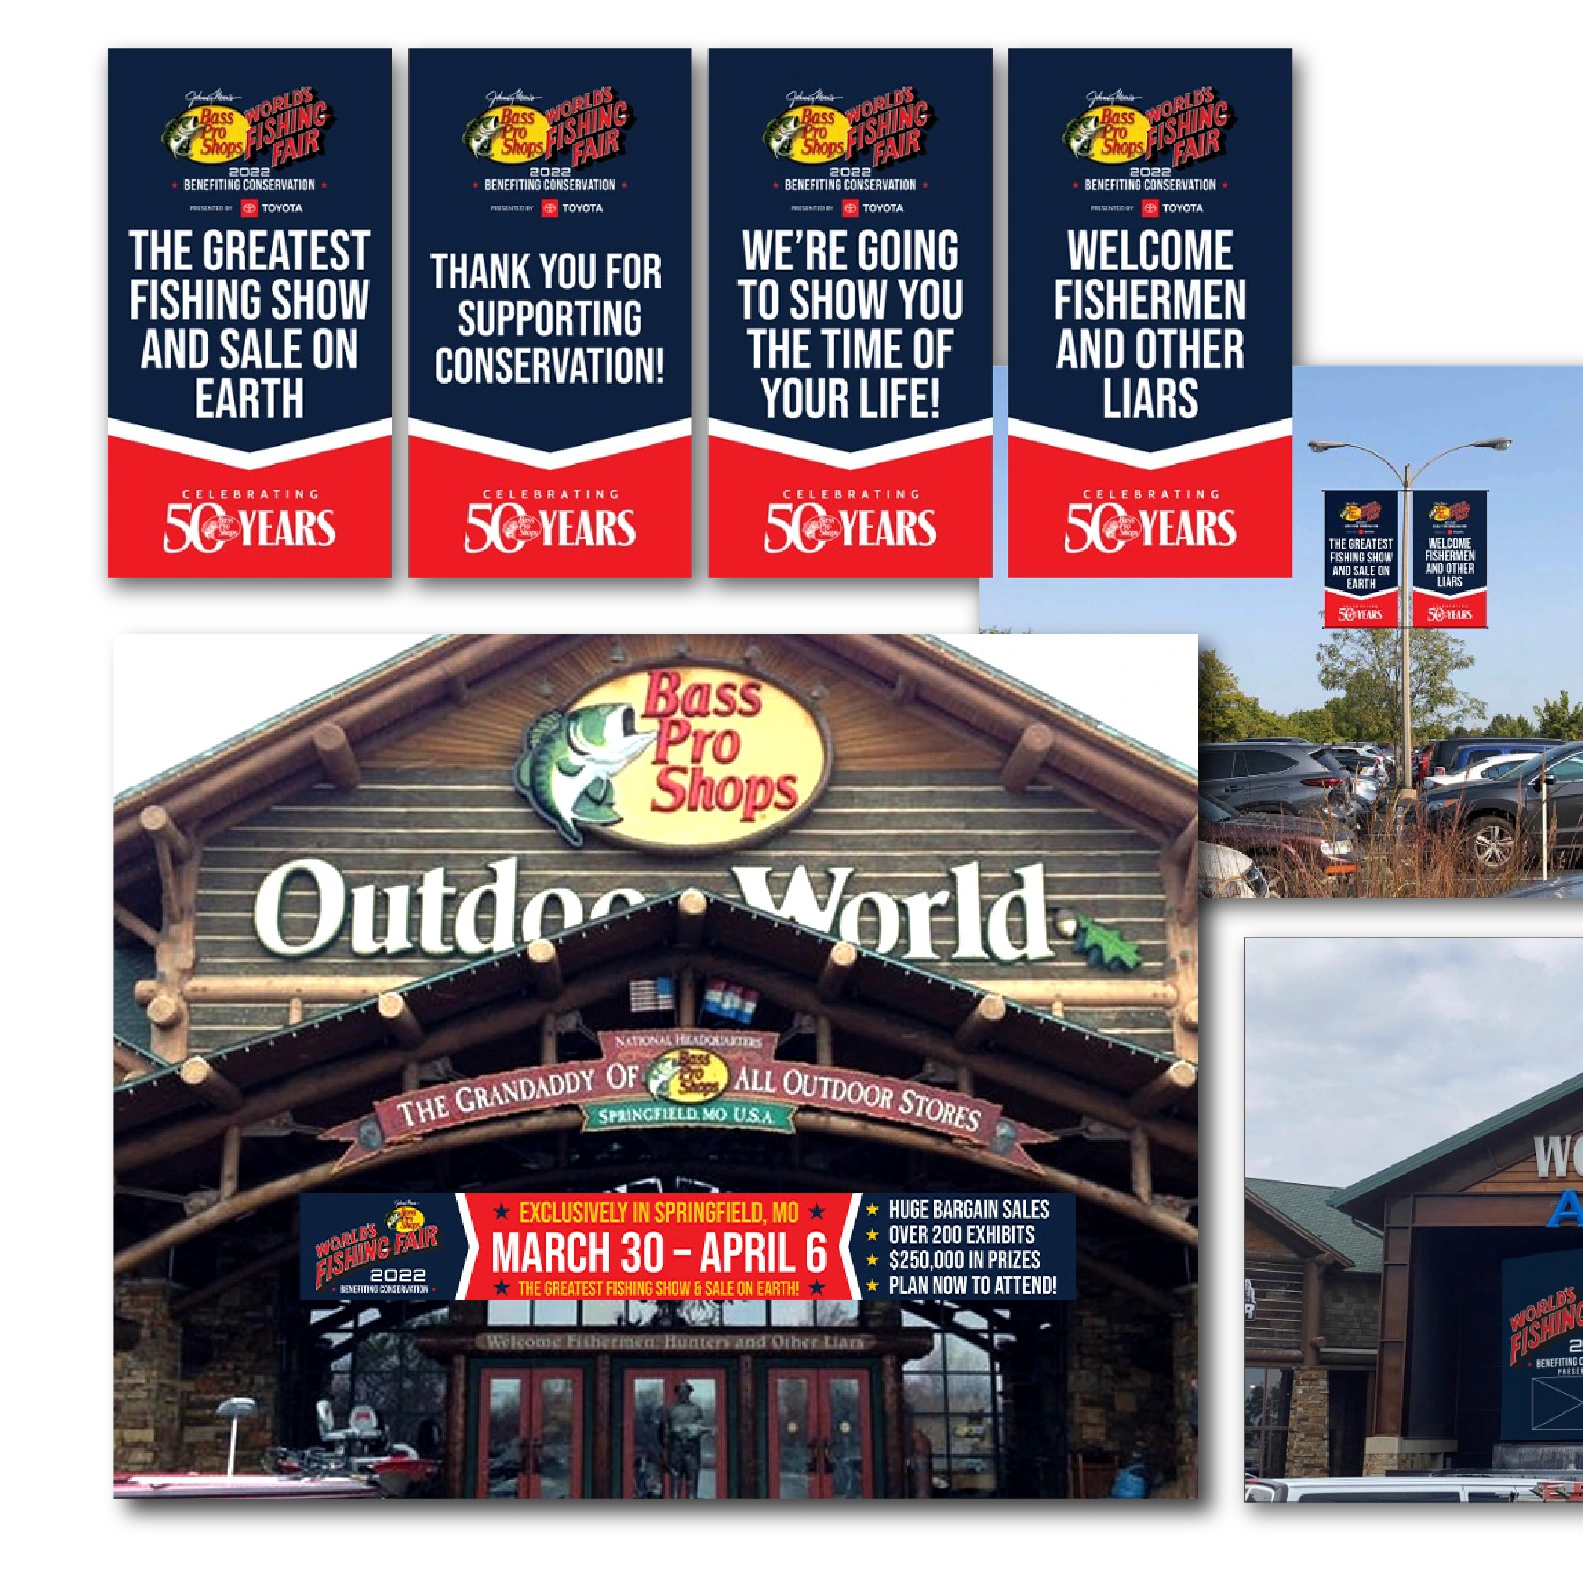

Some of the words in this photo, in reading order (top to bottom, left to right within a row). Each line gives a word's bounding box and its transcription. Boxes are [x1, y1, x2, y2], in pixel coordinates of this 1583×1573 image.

[200, 108, 234, 124] Bass
[244, 86, 314, 123] WORLD'S
[200, 124, 226, 139] Pro
[200, 138, 244, 158] Shops
[244, 101, 328, 161] FISHING
[272, 128, 320, 168] FAIR
[184, 178, 240, 190] BENEFITING
[243, 178, 316, 190] CONSERVATION
[229, 167, 270, 178] 2022
[262, 204, 302, 213] TOYOTA
[128, 229, 193, 271] THE
[203, 229, 371, 271] GREATEST
[742, 229, 848, 271] WE'RE
[858, 229, 958, 271] GOING
[1067, 229, 1234, 271] WELCOME
[430, 253, 529, 289] THANK
[538, 253, 595, 289] YOU
[606, 253, 662, 289] FOR
[130, 279, 261, 321] FISHING
[271, 279, 370, 321] SHOW
[457, 300, 642, 336] SUPPORTING
[737, 279, 779, 321] TO
[789, 279, 886, 321] SHOW
[899, 279, 964, 321] YOU
[1055, 279, 1246, 321] FISHERMEN
[141, 328, 209, 369] AND
[220, 328, 302, 369] SALE
[313, 328, 358, 369] ON
[435, 347, 664, 385] CONSERVATION!
[746, 328, 810, 369] THE
[821, 328, 902, 369] TIME
[913, 328, 954, 369] OF
[1056, 328, 1124, 369] AND
[1136, 328, 1245, 369] OTHER
[195, 377, 304, 419] EARTH
[760, 377, 848, 419] YOUR
[859, 377, 940, 419] LIFE!
[1103, 377, 1198, 419] LIARS
[182, 490, 318, 499] CELEBRATING
[164, 502, 226, 553] 50
[238, 509, 336, 546] YEARS
[1329, 538, 1346, 549] THE
[1348, 538, 1394, 549] GREATEST
[1429, 538, 1472, 549] WELCOME
[1330, 552, 1365, 563] FISHING
[1367, 552, 1394, 563] SHOW
[1332, 566, 1350, 576] AND
[1354, 566, 1376, 576] SALE
[1378, 566, 1390, 576] ON
[1426, 550, 1476, 561] FISHERMEN
[1426, 562, 1444, 574] AND
[1446, 562, 1474, 574] OTHER
[1346, 578, 1376, 589] EARTH
[1437, 576, 1462, 586] LIARS
[641, 669, 763, 718] Bass
[651, 718, 742, 765] Pro
[650, 764, 799, 823] Shops
[254, 856, 648, 956] Outdo
[731, 861, 1056, 961] World
[616, 1036, 672, 1047] NATIONAL
[397, 1095, 450, 1127] THE
[455, 1069, 594, 1113] GRANDADDY
[606, 1062, 639, 1090] OF
[734, 1066, 777, 1093] ALL
[783, 1069, 894, 1110] OUTDOOR
[898, 1089, 982, 1132] STORES
[702, 1107, 726, 1122] MO
[520, 1201, 628, 1223] EXCLUSIVELY
[633, 1201, 650, 1223] IN
[654, 1201, 767, 1226] SPRINGFIELD,
[772, 1201, 799, 1223] MO
[889, 1199, 929, 1220] HUGE
[933, 1199, 999, 1220] BARGAIN
[1002, 1199, 1050, 1220] SALES
[492, 1231, 610, 1274] MARCH
[620, 1231, 664, 1274] 30
[700, 1231, 796, 1274] APRIL
[806, 1231, 828, 1274] 6
[889, 1225, 928, 1244] OVER
[932, 1225, 962, 1244] 200
[967, 1225, 1034, 1244] EXHIBITS
[889, 1250, 964, 1272] $250,000
[968, 1250, 983, 1270] IN
[988, 1250, 1041, 1270] PRIZES
[889, 1276, 929, 1295] PLAN
[933, 1276, 968, 1295] NOW
[972, 1276, 991, 1295] TO
[995, 1276, 1057, 1295] ATTEND!
[487, 1334, 561, 1350] Welcome
[664, 1334, 730, 1350] Hunters
[736, 1334, 766, 1350] and
[771, 1334, 818, 1350] Other
